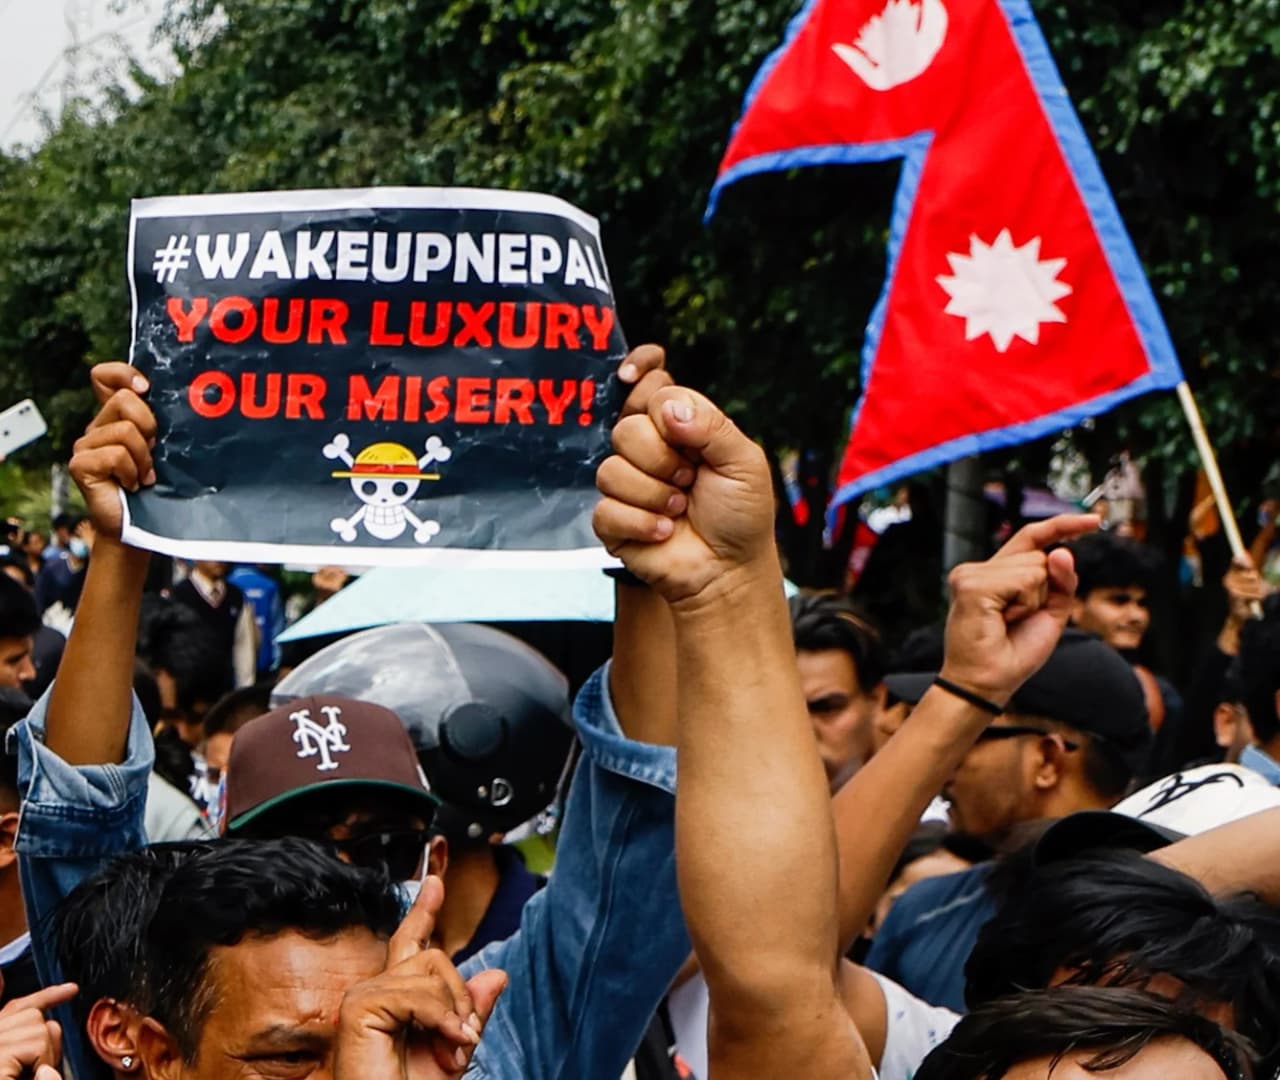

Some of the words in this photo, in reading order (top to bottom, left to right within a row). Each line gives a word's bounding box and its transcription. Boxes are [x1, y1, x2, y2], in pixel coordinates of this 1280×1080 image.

[153, 230, 609, 294] #WAKEUPNEPAL
[167, 296, 348, 344] YOUR
[370, 301, 614, 351] LUXURY
[189, 371, 327, 420] OUR
[347, 375, 595, 426] MISERY!
